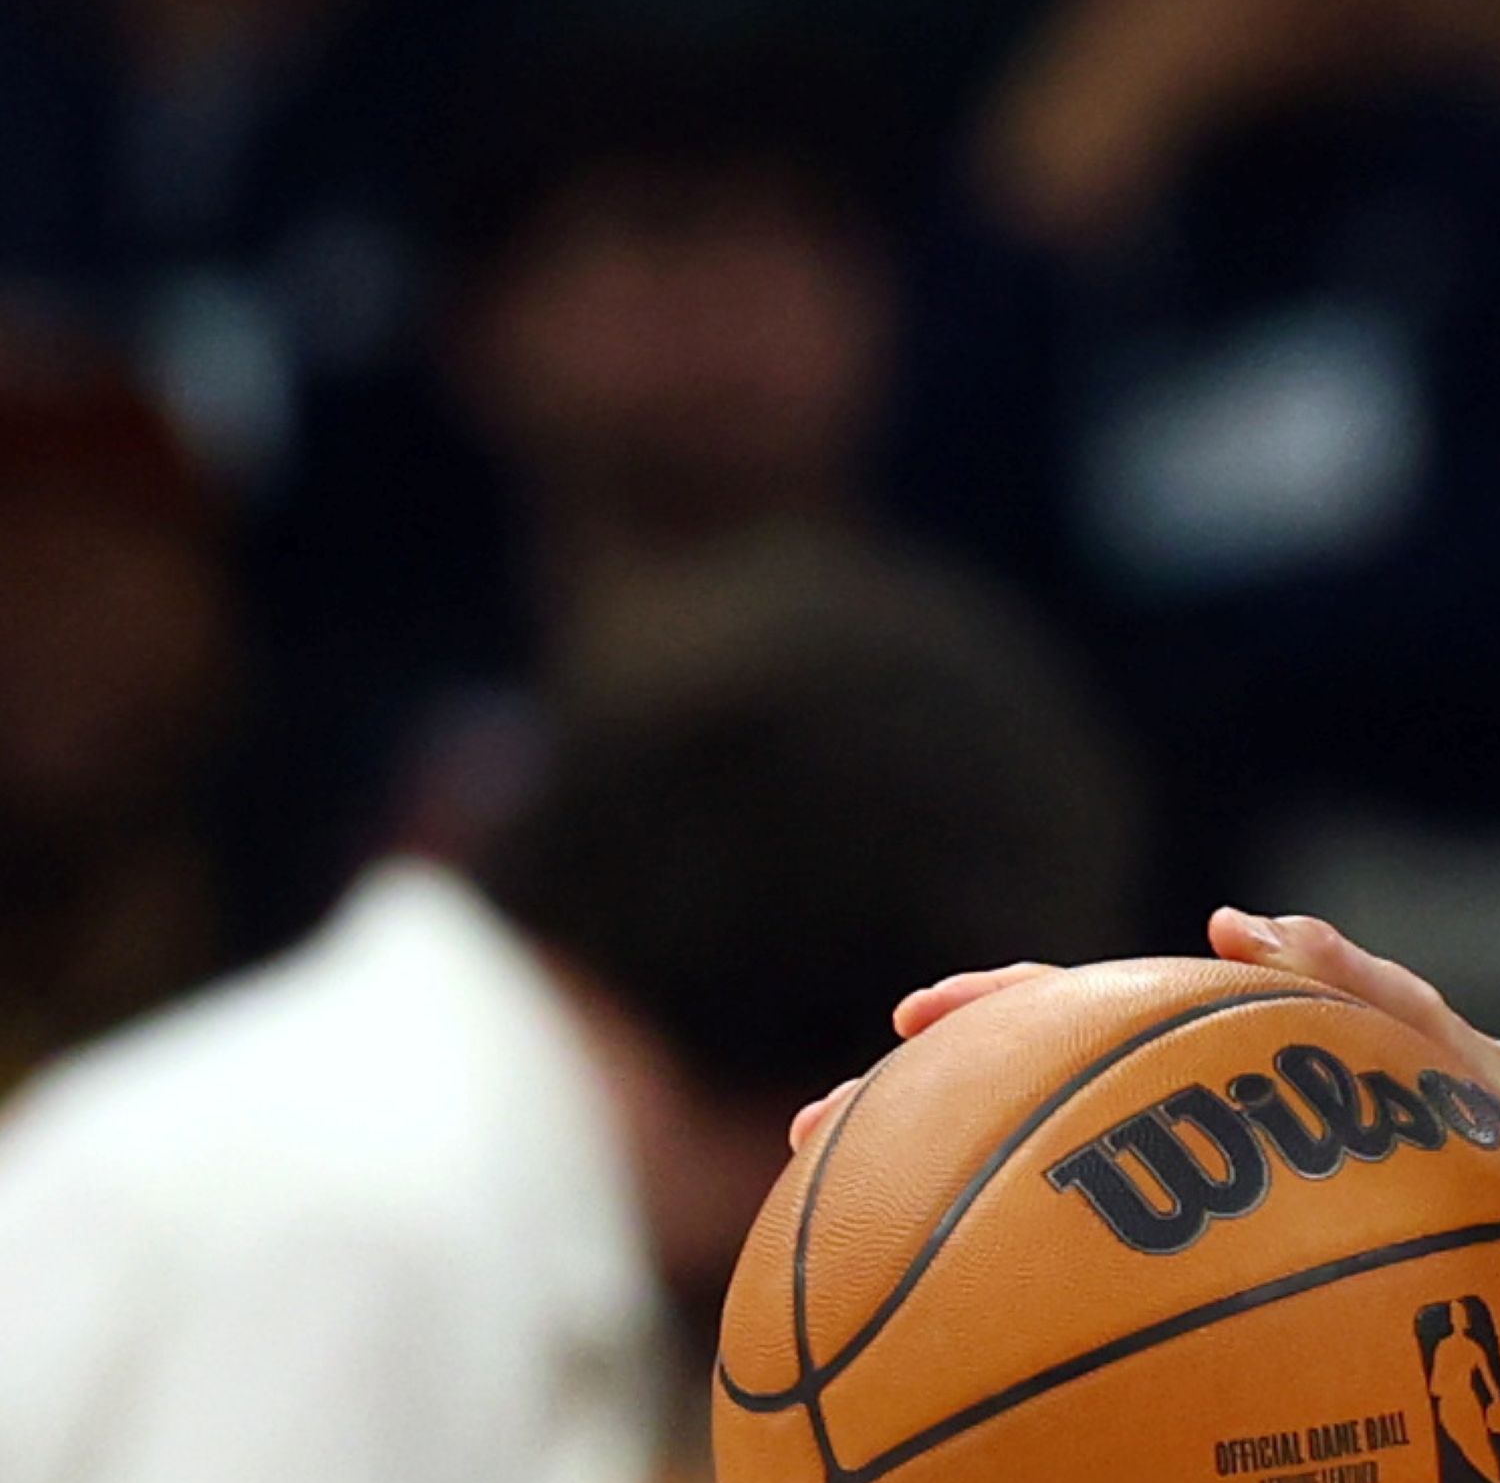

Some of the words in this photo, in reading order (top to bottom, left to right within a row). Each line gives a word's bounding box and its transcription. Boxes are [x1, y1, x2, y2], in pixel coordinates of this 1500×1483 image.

[1215, 1431, 1304, 1477] OFFICIAL
[1307, 1420, 1361, 1461] GAME
[1364, 1411, 1410, 1451] BALL
